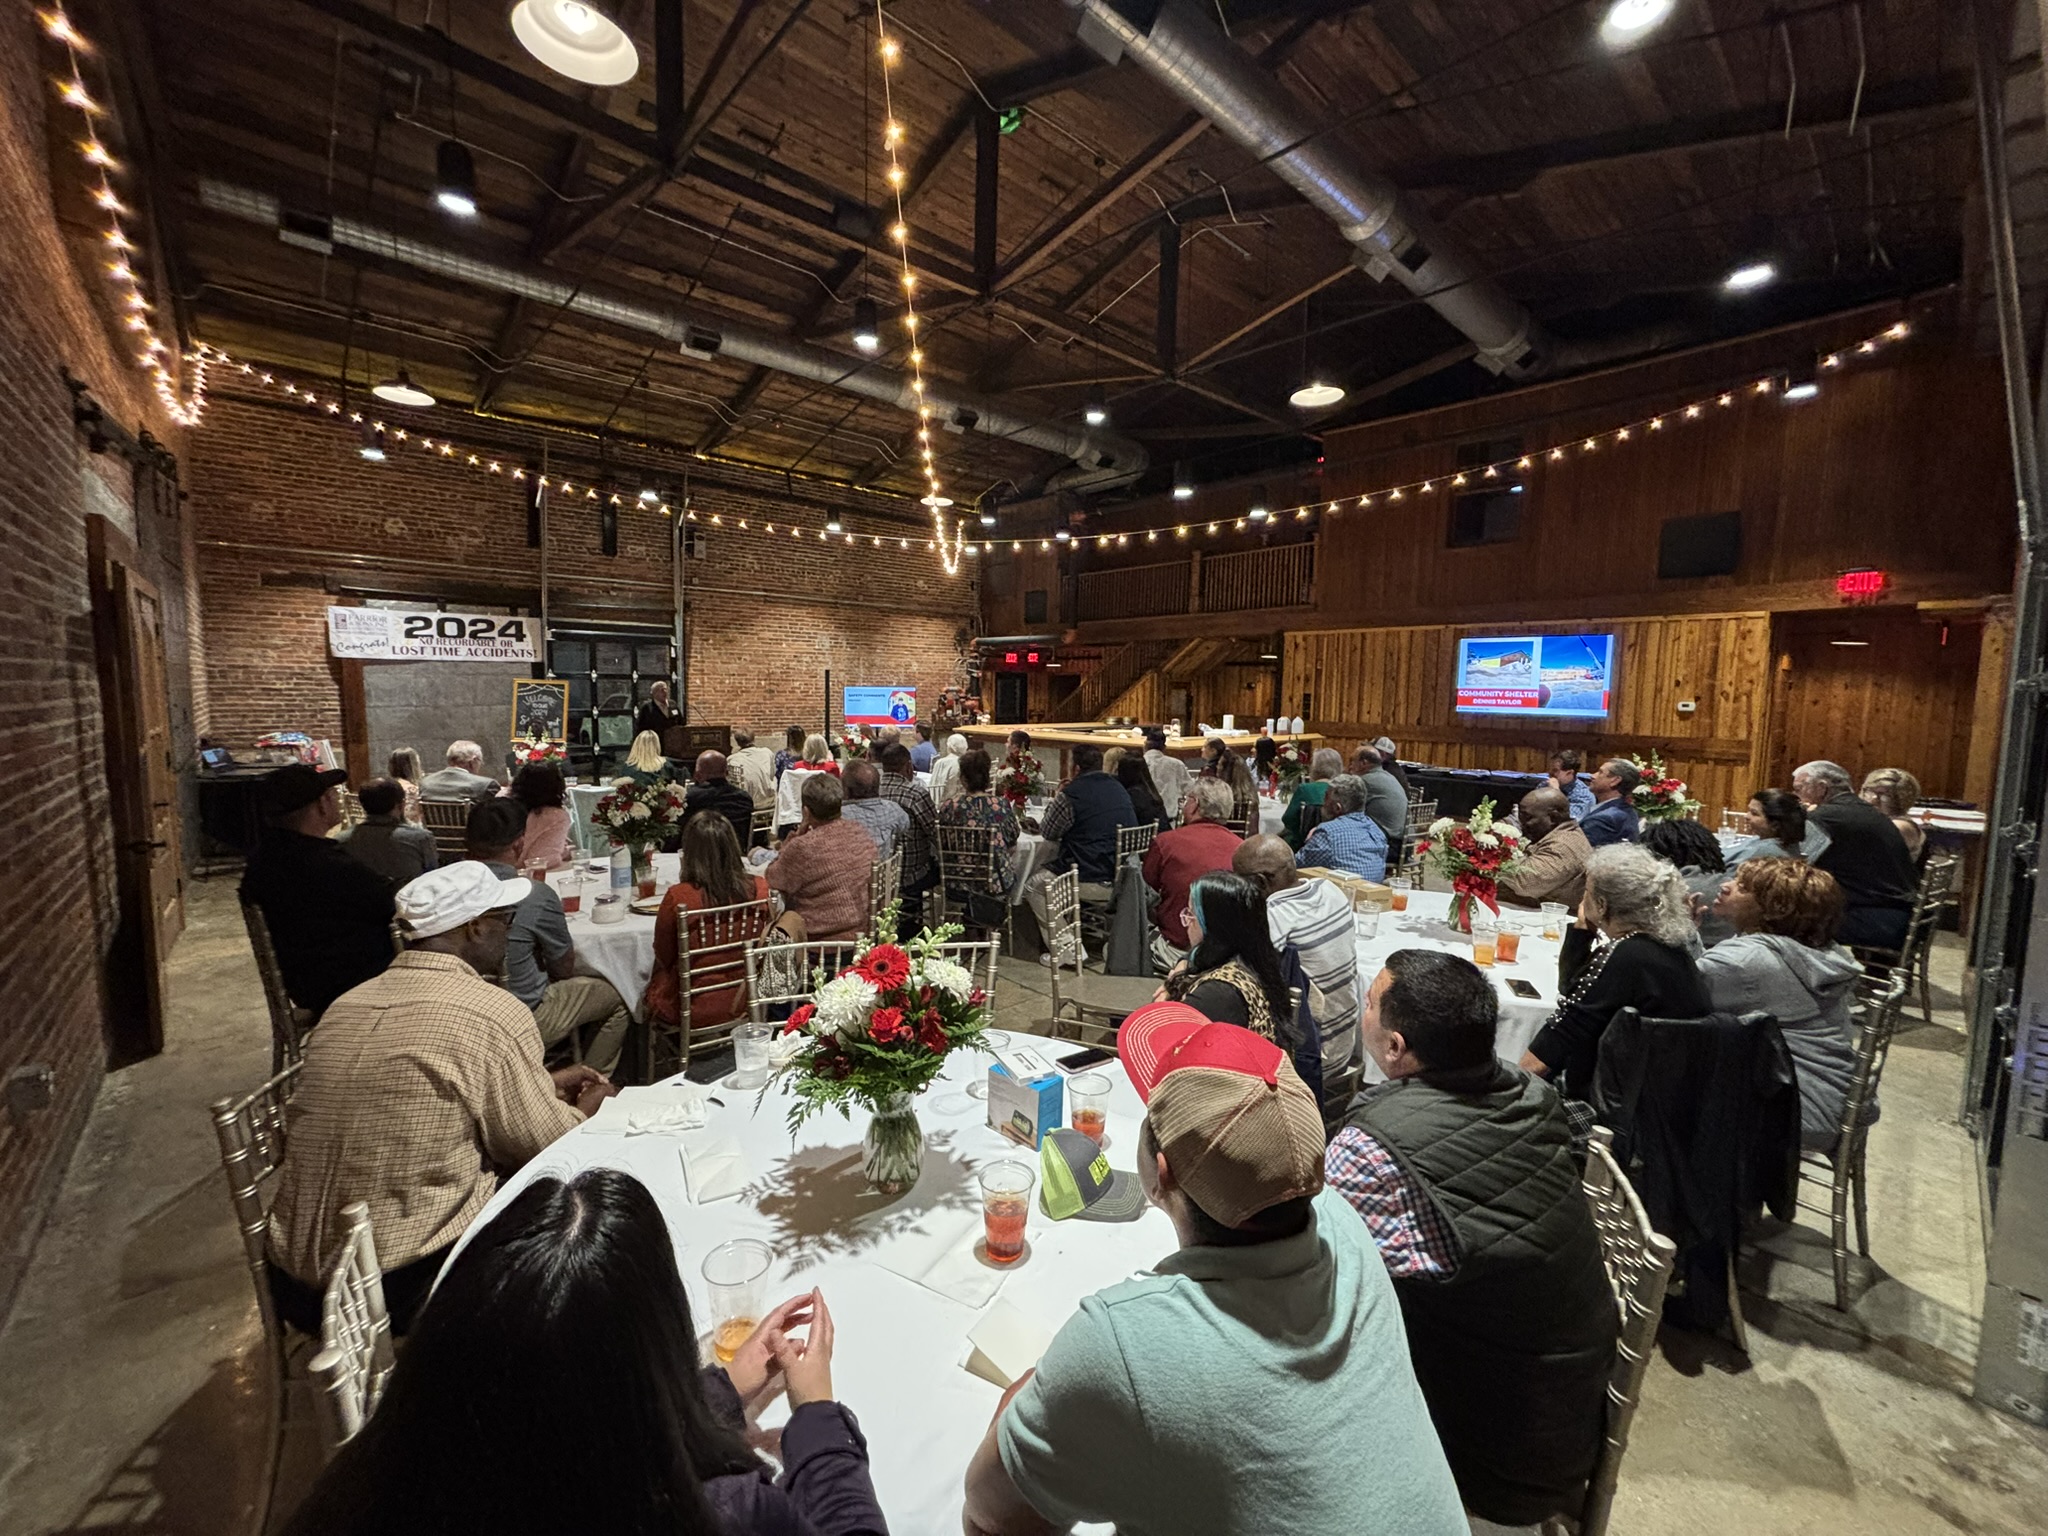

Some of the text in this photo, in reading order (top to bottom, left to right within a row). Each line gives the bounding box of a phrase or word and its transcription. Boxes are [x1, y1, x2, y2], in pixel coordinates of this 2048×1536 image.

[1844, 571, 1878, 591] EXIT
[403, 616, 526, 642] 2024
[336, 637, 389, 653] Congrats!
[419, 637, 513, 648] NO RECORDABLE OR
[392, 645, 537, 658] LOST TIME ACCIDENTS!
[1505, 690, 1539, 698] SHELTER
